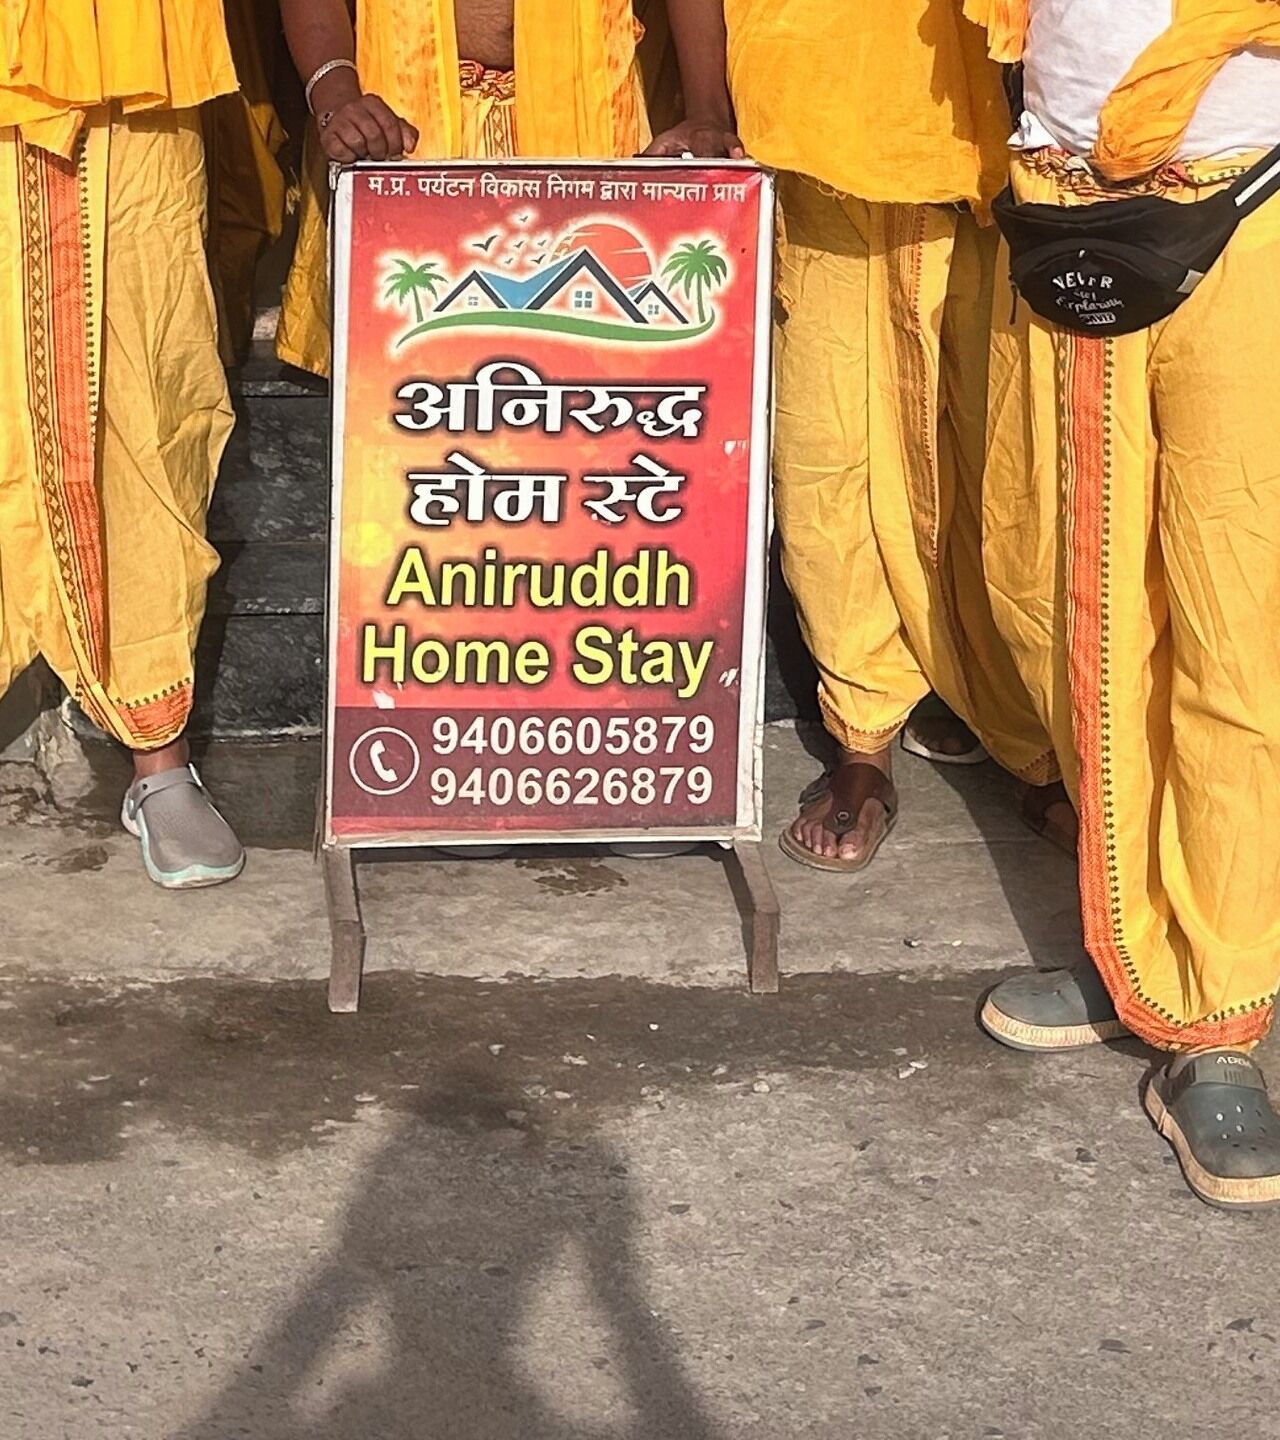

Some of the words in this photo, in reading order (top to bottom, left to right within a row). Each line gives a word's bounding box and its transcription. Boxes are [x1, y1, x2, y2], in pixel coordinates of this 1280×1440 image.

[368, 176, 411, 196] म.प्र.
[417, 171, 476, 197] पर्यटन
[480, 172, 542, 198] विकास
[547, 173, 595, 199] निगम
[599, 180, 638, 201] द्वारा
[642, 181, 709, 202] मान्यता
[712, 183, 748, 203] प्राप्त
[394, 361, 707, 437] अनिरुद्ध
[407, 451, 568, 526] होम
[582, 453, 686, 523] स्टे
[386, 547, 690, 606] Aniruddh
[362, 624, 550, 684] Home
[572, 625, 714, 699] Stay
[431, 714, 715, 755] 9406605879
[429, 765, 714, 806] 9406626879
